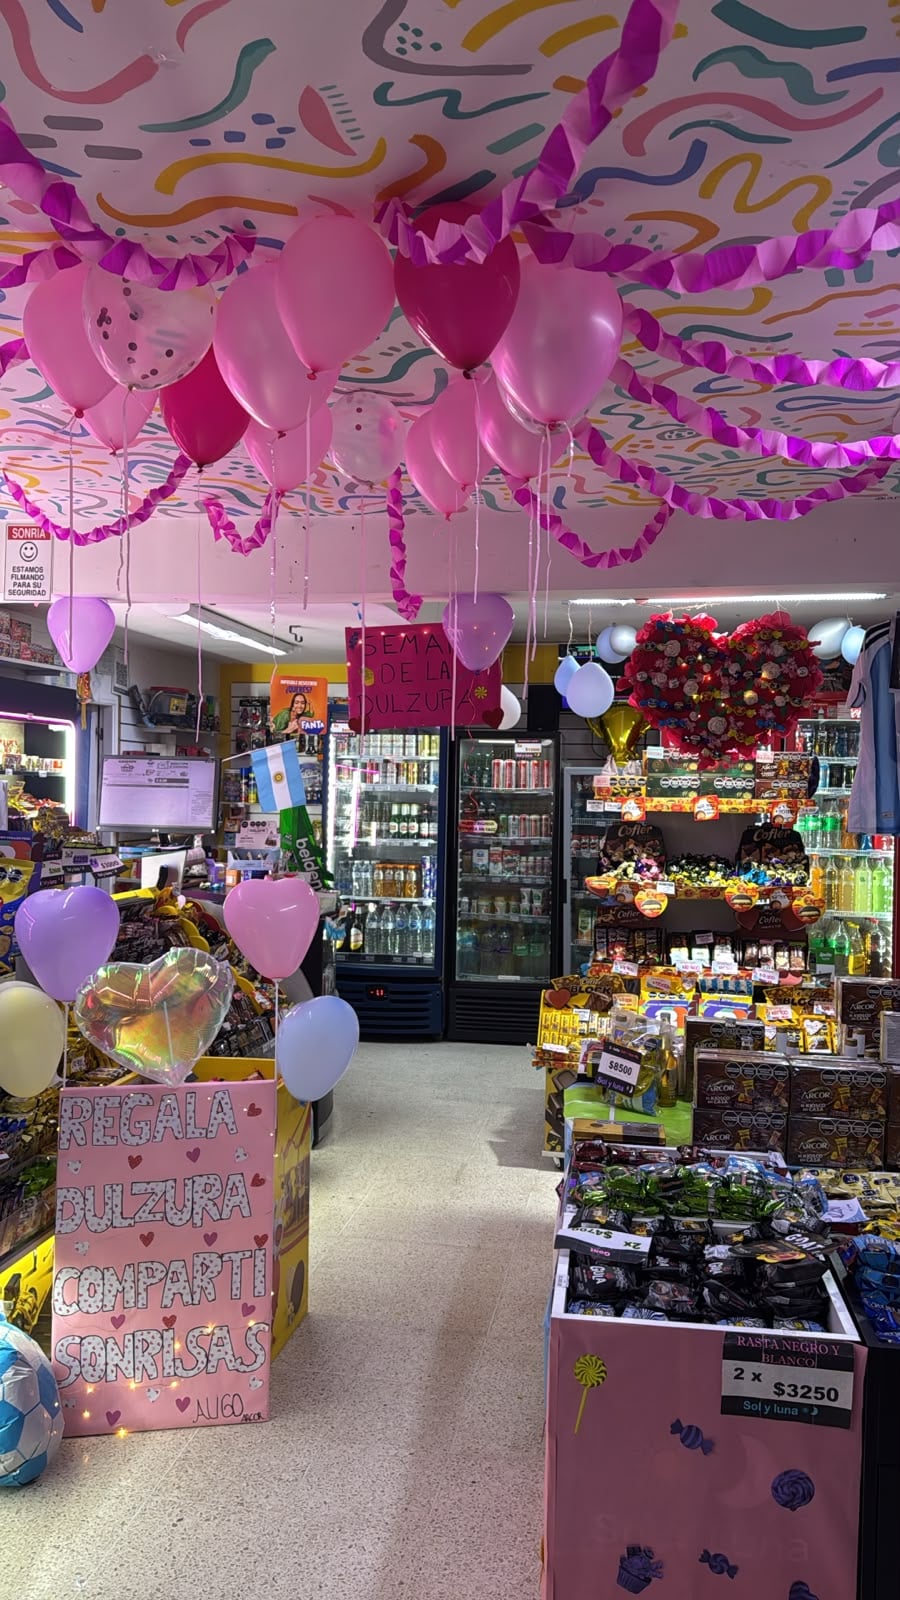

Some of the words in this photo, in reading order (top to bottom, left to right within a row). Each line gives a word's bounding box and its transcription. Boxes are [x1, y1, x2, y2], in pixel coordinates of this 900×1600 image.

[12, 527, 46, 539] SONRIA
[363, 633, 452, 657] SEMA
[380, 662, 413, 685] DE
[426, 660, 451, 681] LA
[301, 720, 325, 730] FANTA
[618, 824, 651, 837] Cofler
[753, 828, 791, 841] Cofler
[570, 985, 612, 995] BLOCK
[608, 1060, 633, 1076] $8500
[706, 1083, 735, 1092] ARCOR
[801, 1091, 831, 1099] ARCOR
[59, 1089, 238, 1150] REGALA
[702, 1133, 731, 1141] ARCOR
[799, 1142, 828, 1150] ARCOR
[55, 1172, 252, 1235] DULZURA
[53, 1247, 266, 1317] COMPARTI
[737, 1335, 779, 1350] RASTA
[782, 1340, 829, 1355] NEGRO
[831, 1345, 840, 1356] Y
[54, 1322, 271, 1390] SONRISAS
[761, 1353, 815, 1368] BLANCO
[733, 1367, 745, 1380] 2
[751, 1371, 762, 1382] x
[773, 1381, 839, 1403] $3250
[743, 1400, 761, 1411] Sol
[763, 1403, 772, 1415] y
[774, 1401, 799, 1415] luna
